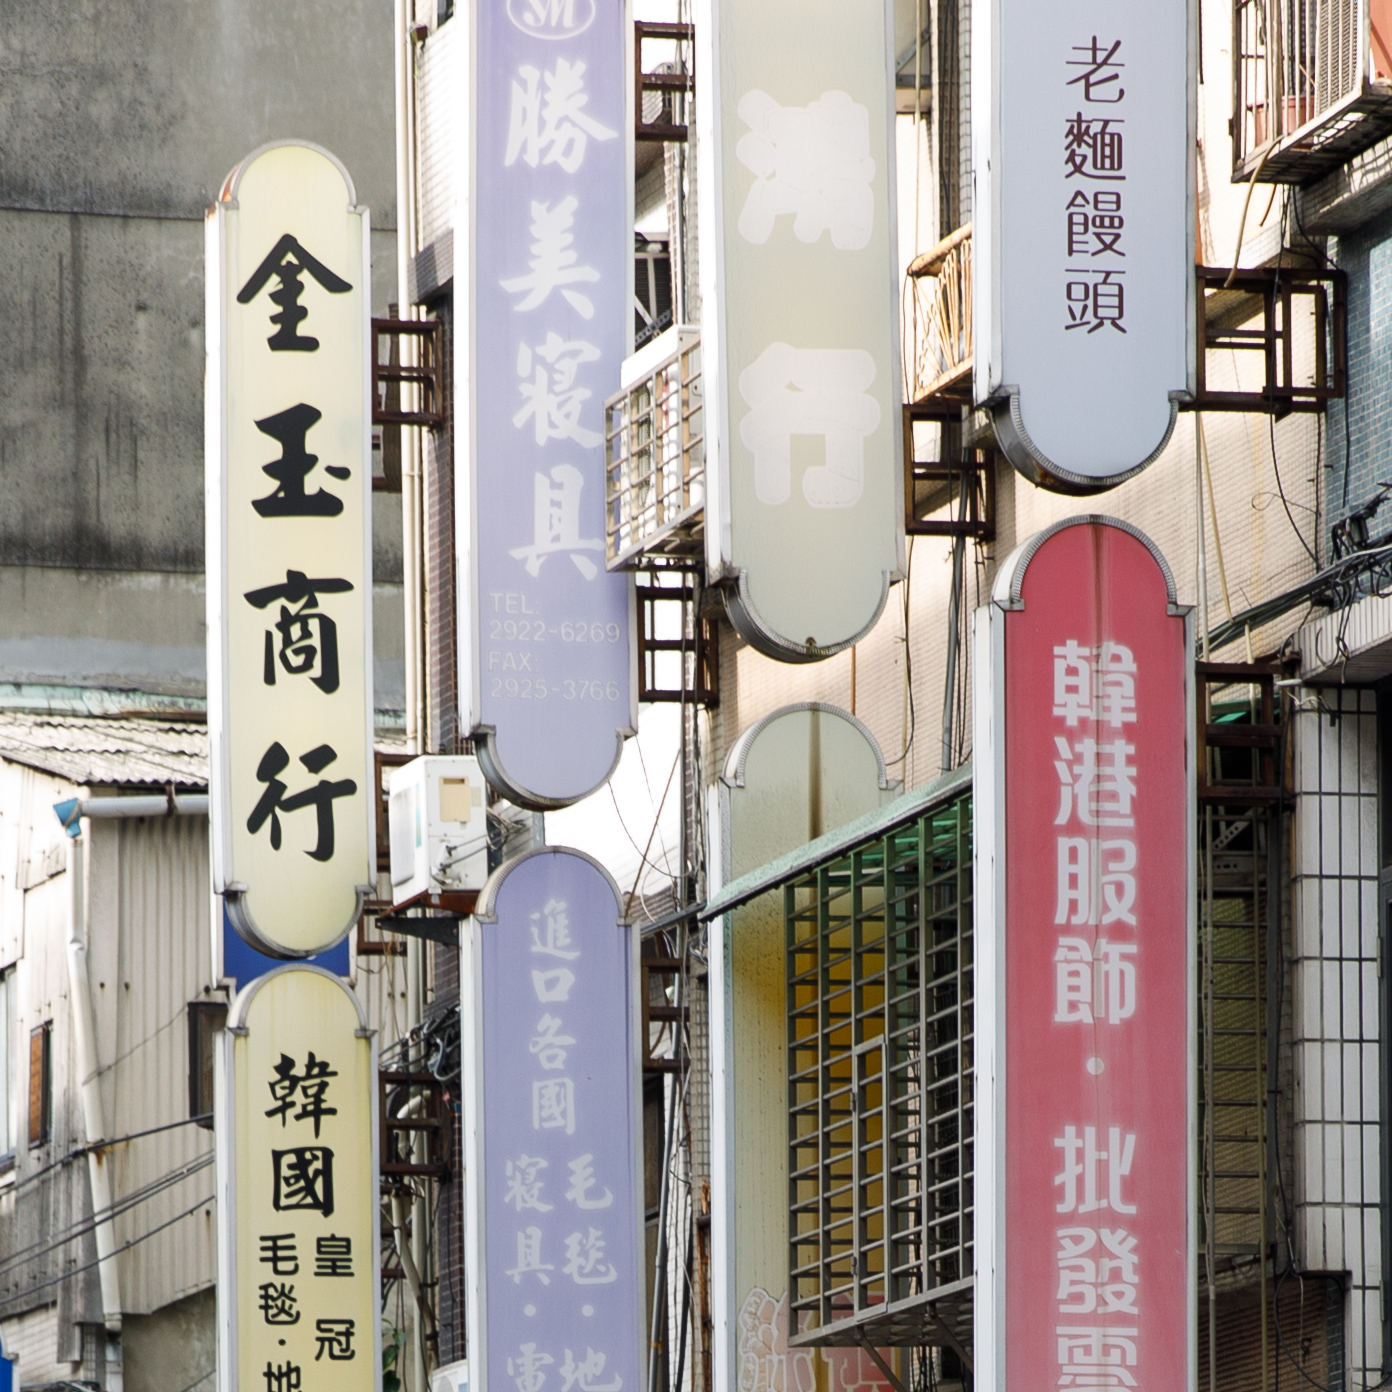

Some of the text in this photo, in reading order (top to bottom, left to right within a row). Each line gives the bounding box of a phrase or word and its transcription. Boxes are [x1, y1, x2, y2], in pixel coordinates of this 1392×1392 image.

[1064, 35, 1127, 335] 老麵饅頭
[500, 58, 619, 581] 勝美寢具
[490, 592, 540, 615] TEL:
[490, 619, 620, 644] 2922-6269
[489, 651, 539, 673] FAX:
[490, 678, 620, 702] 2925-3766
[529, 898, 581, 1136] 進口各國
[265, 1051, 337, 1218] 韓國
